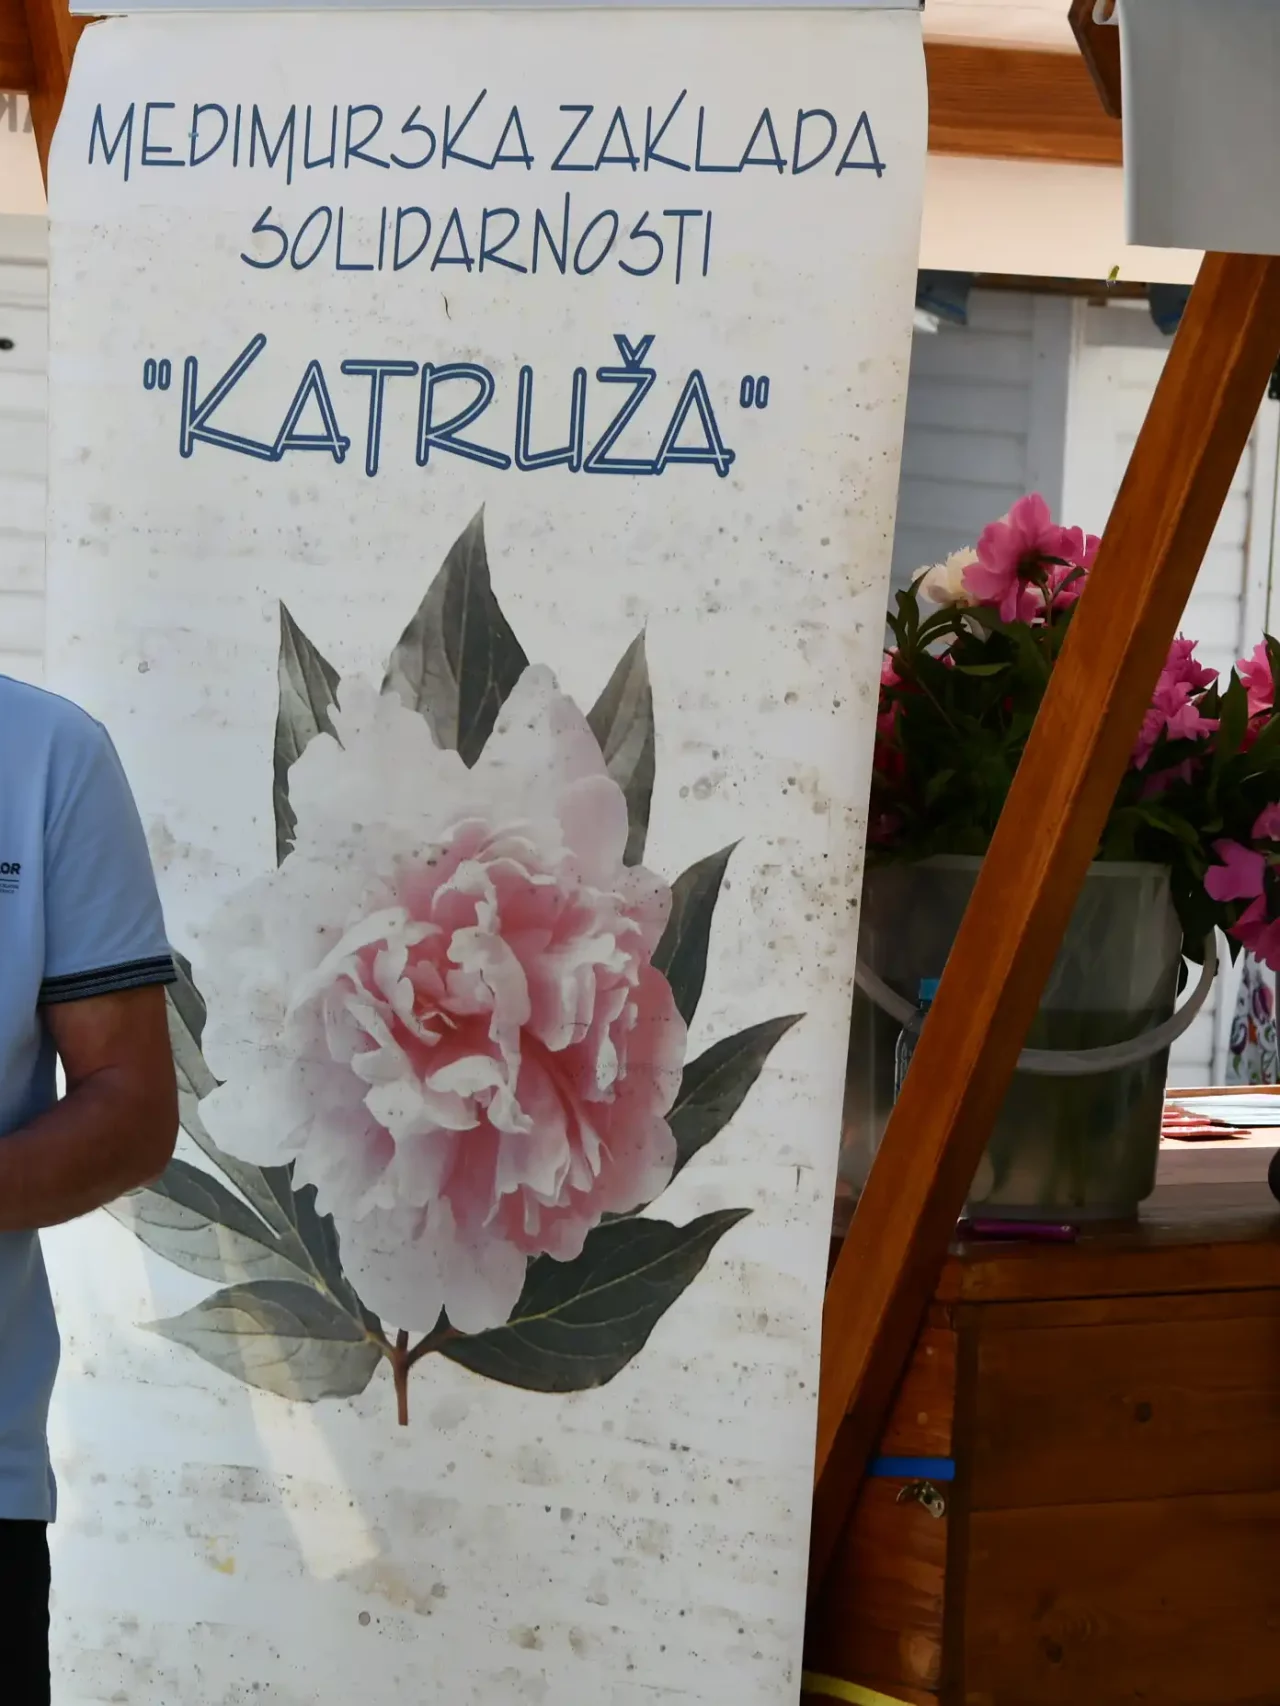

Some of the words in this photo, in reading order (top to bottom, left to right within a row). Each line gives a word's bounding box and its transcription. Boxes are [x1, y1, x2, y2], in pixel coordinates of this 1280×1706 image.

[88, 88, 535, 186] MEĐIMURSKA
[550, 88, 888, 178] ZAKLADA
[240, 191, 714, 285] SOLIDARNOSTI
[143, 333, 770, 477] "KATRUŽA"
